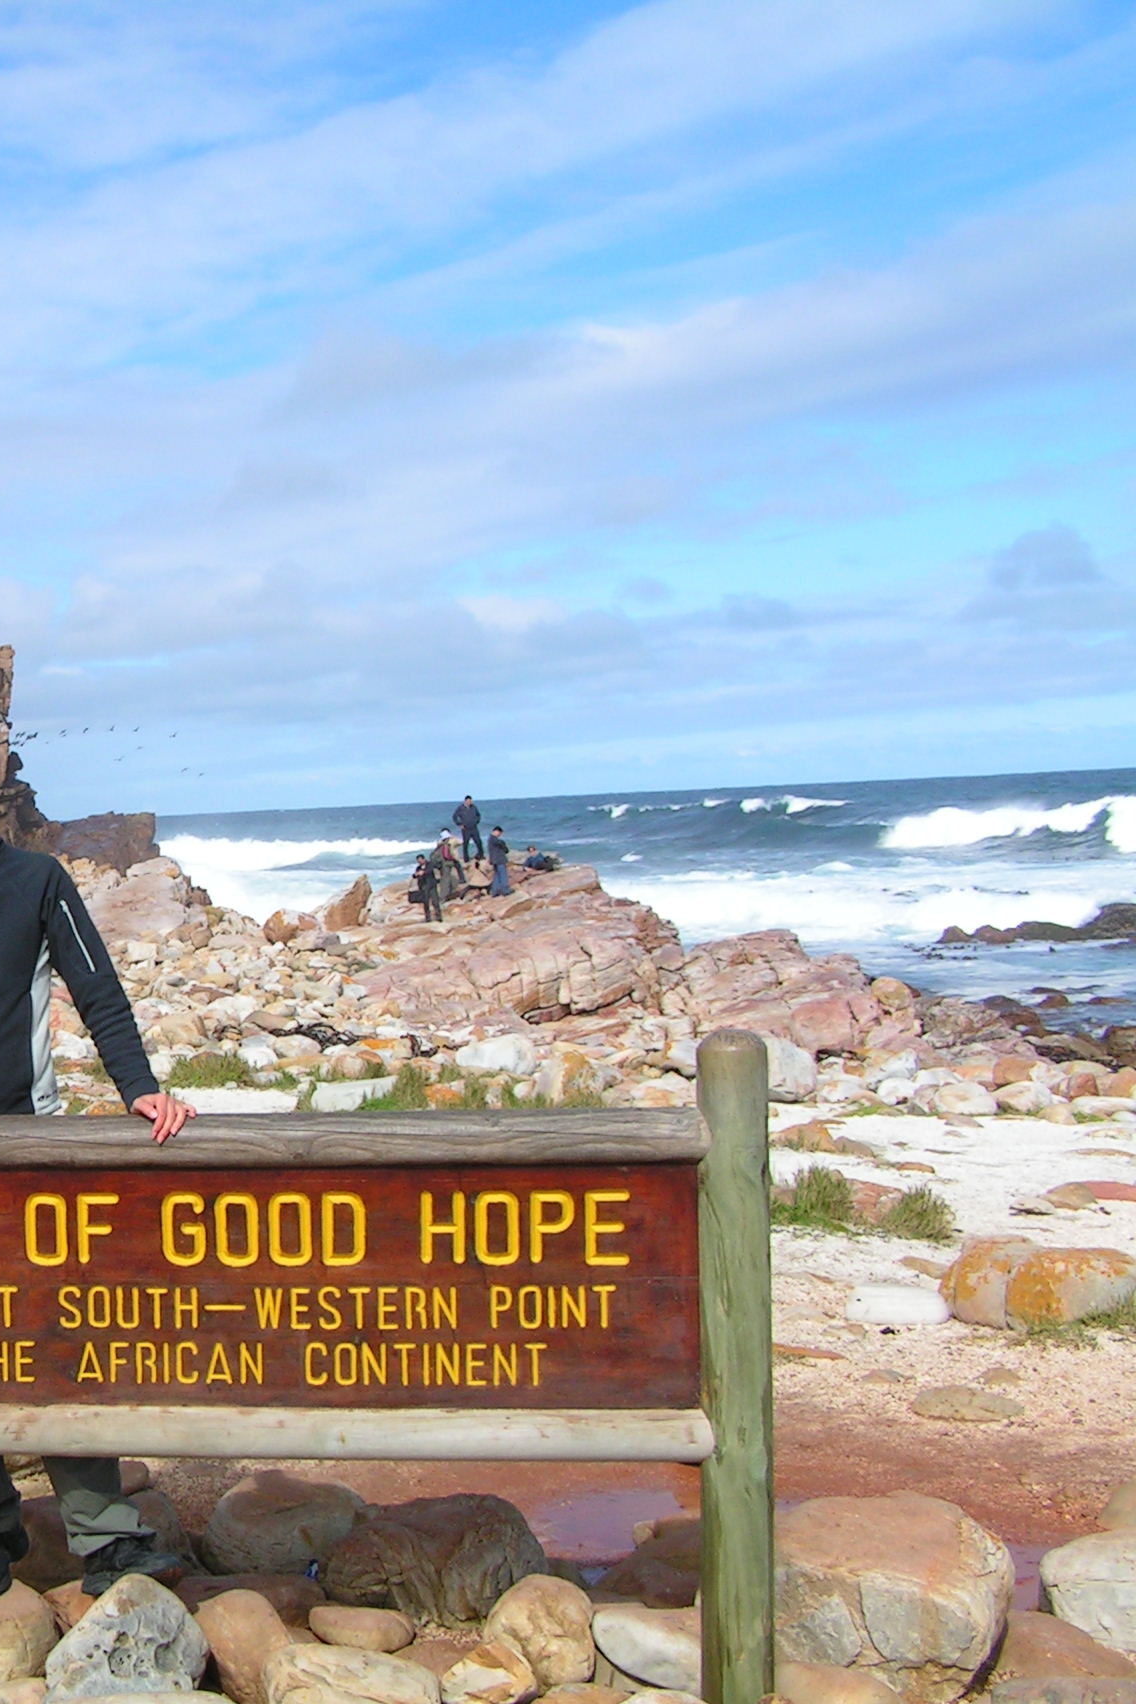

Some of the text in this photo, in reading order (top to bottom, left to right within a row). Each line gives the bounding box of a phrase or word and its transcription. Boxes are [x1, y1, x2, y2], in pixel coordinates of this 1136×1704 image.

[23, 1192, 120, 1268] OF
[160, 1190, 367, 1268] GOOD
[418, 1189, 632, 1268] HOPE
[488, 1283, 618, 1331] POINT
[76, 1339, 264, 1386] AFRICAN
[304, 1340, 549, 1388] CONTINENT
